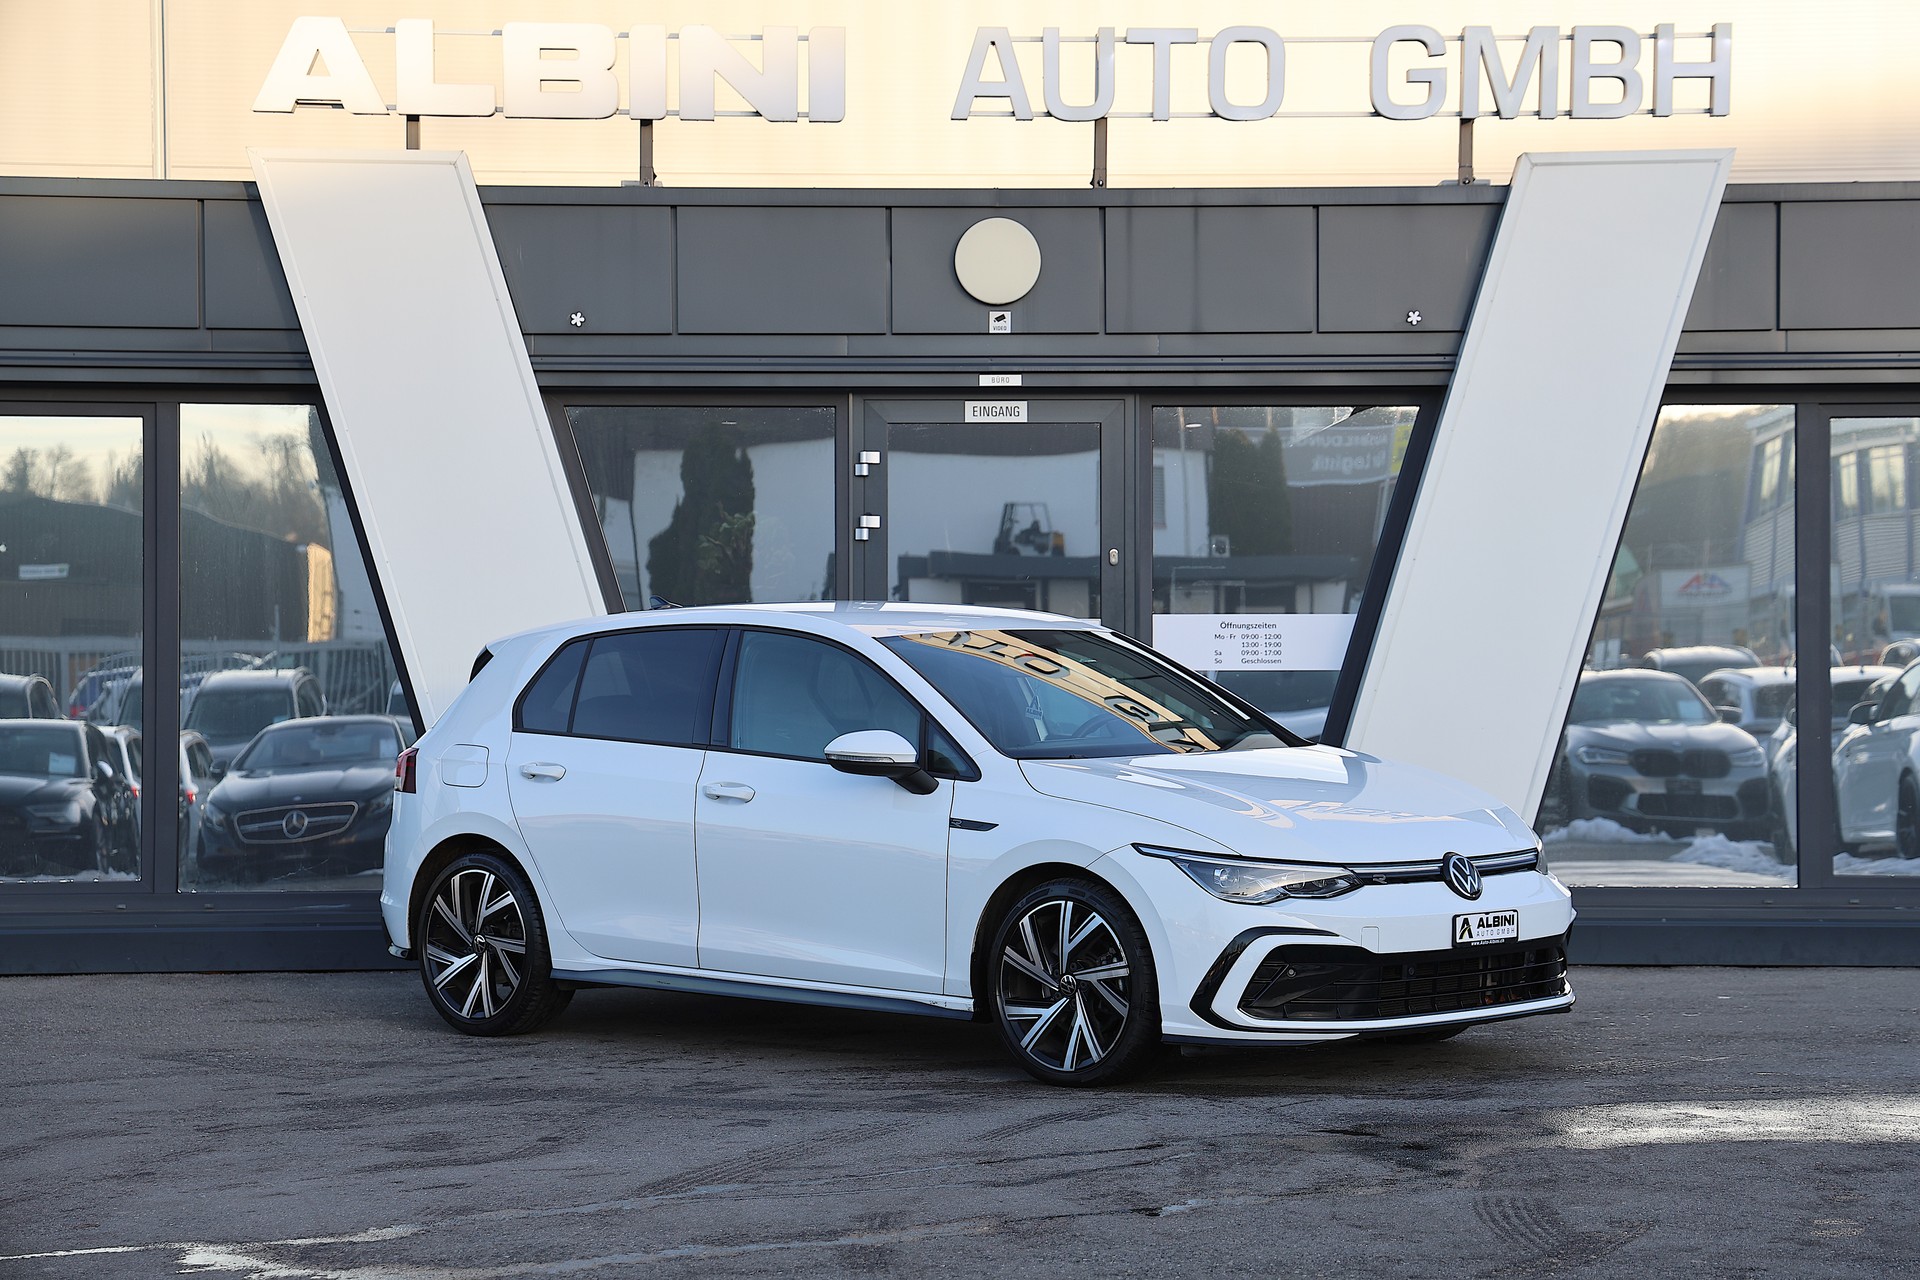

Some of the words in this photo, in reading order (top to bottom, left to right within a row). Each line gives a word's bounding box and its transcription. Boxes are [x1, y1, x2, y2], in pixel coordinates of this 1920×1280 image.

[251, 16, 846, 124] ALBINI
[951, 25, 1286, 122] AUTO
[1370, 23, 1733, 120] GMBH
[972, 405, 1020, 417] EINGANG
[1220, 621, 1277, 630] Öffnungszeiten
[1477, 913, 1515, 929] ALBINI
[1477, 929, 1494, 937] AUTO
[1497, 928, 1515, 936] GMBH
